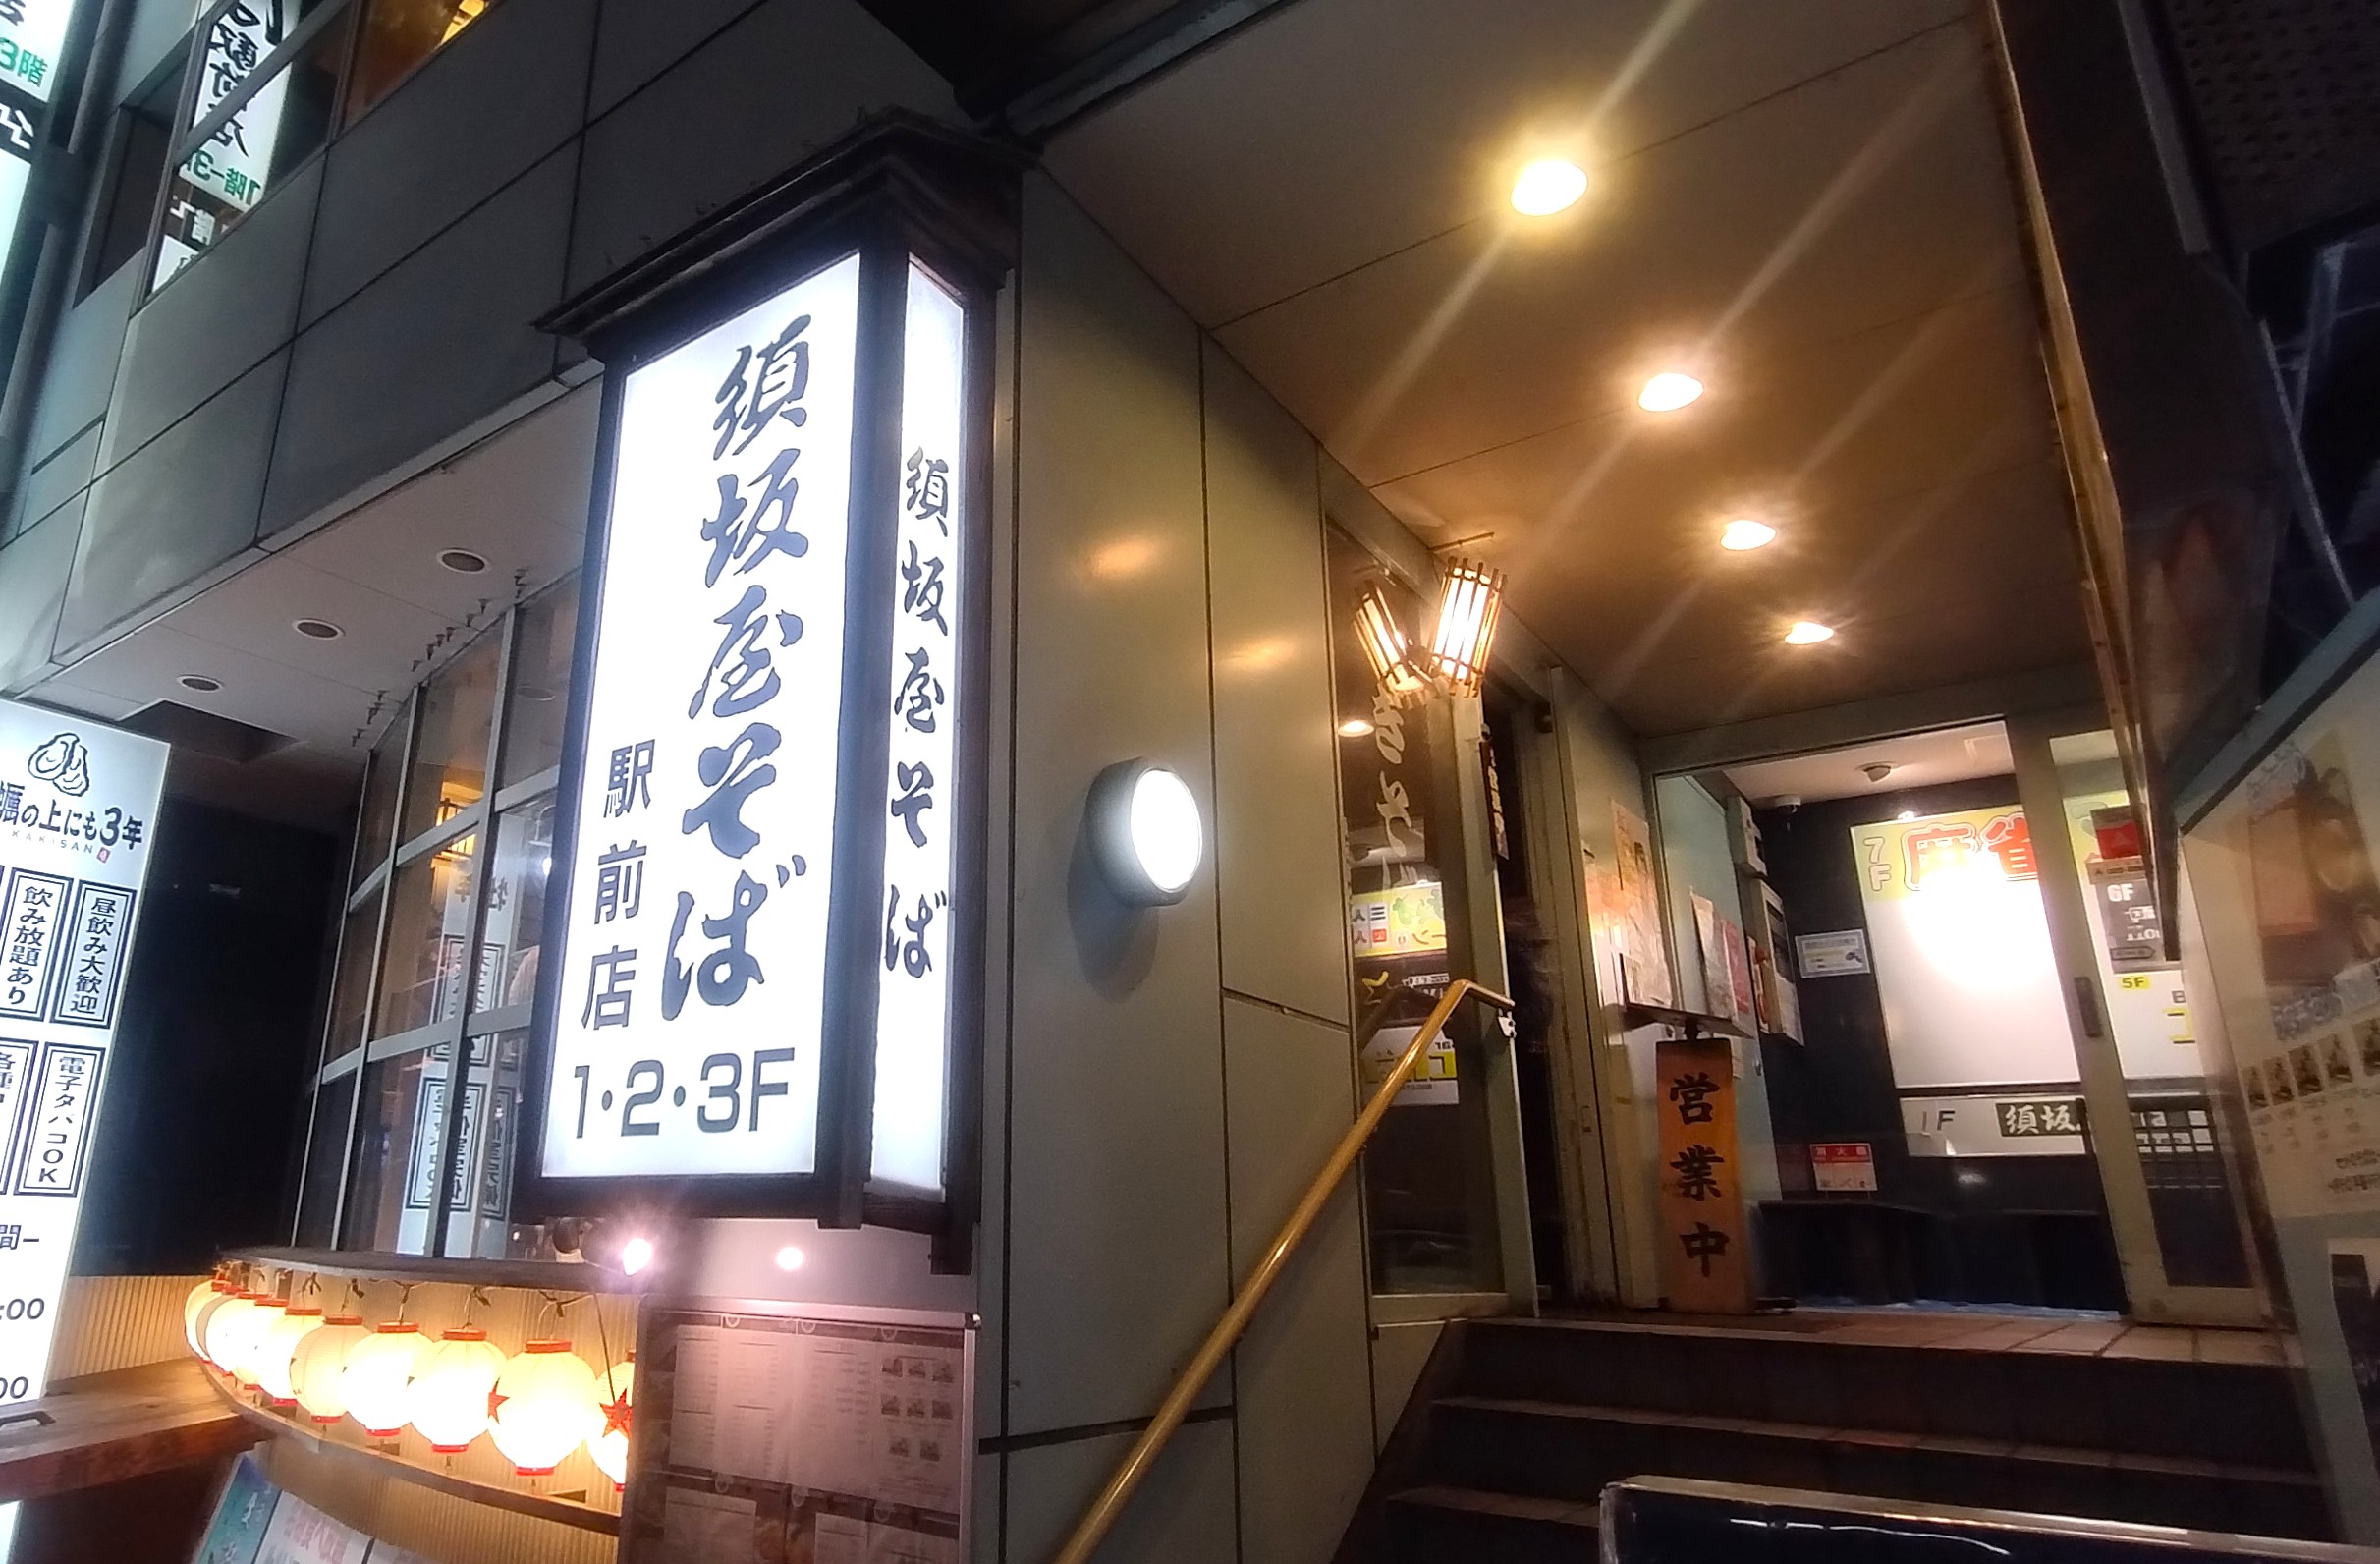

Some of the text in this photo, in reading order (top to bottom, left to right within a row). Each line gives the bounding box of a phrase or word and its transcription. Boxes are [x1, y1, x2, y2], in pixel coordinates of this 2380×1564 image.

[661, 314, 811, 1021] 須坂屋そば
[885, 446, 949, 978] 須坂屋そば
[581, 739, 655, 1030] 駅前店
[2107, 883, 2133, 902] 6F
[7, 885, 54, 1005] 飲み放題あり
[70, 896, 117, 1014] 昼飲み大歓迎
[2122, 977, 2144, 988] 5F
[1670, 1072, 1730, 1277] 営業中
[2005, 1105, 2081, 1134] 須坂
